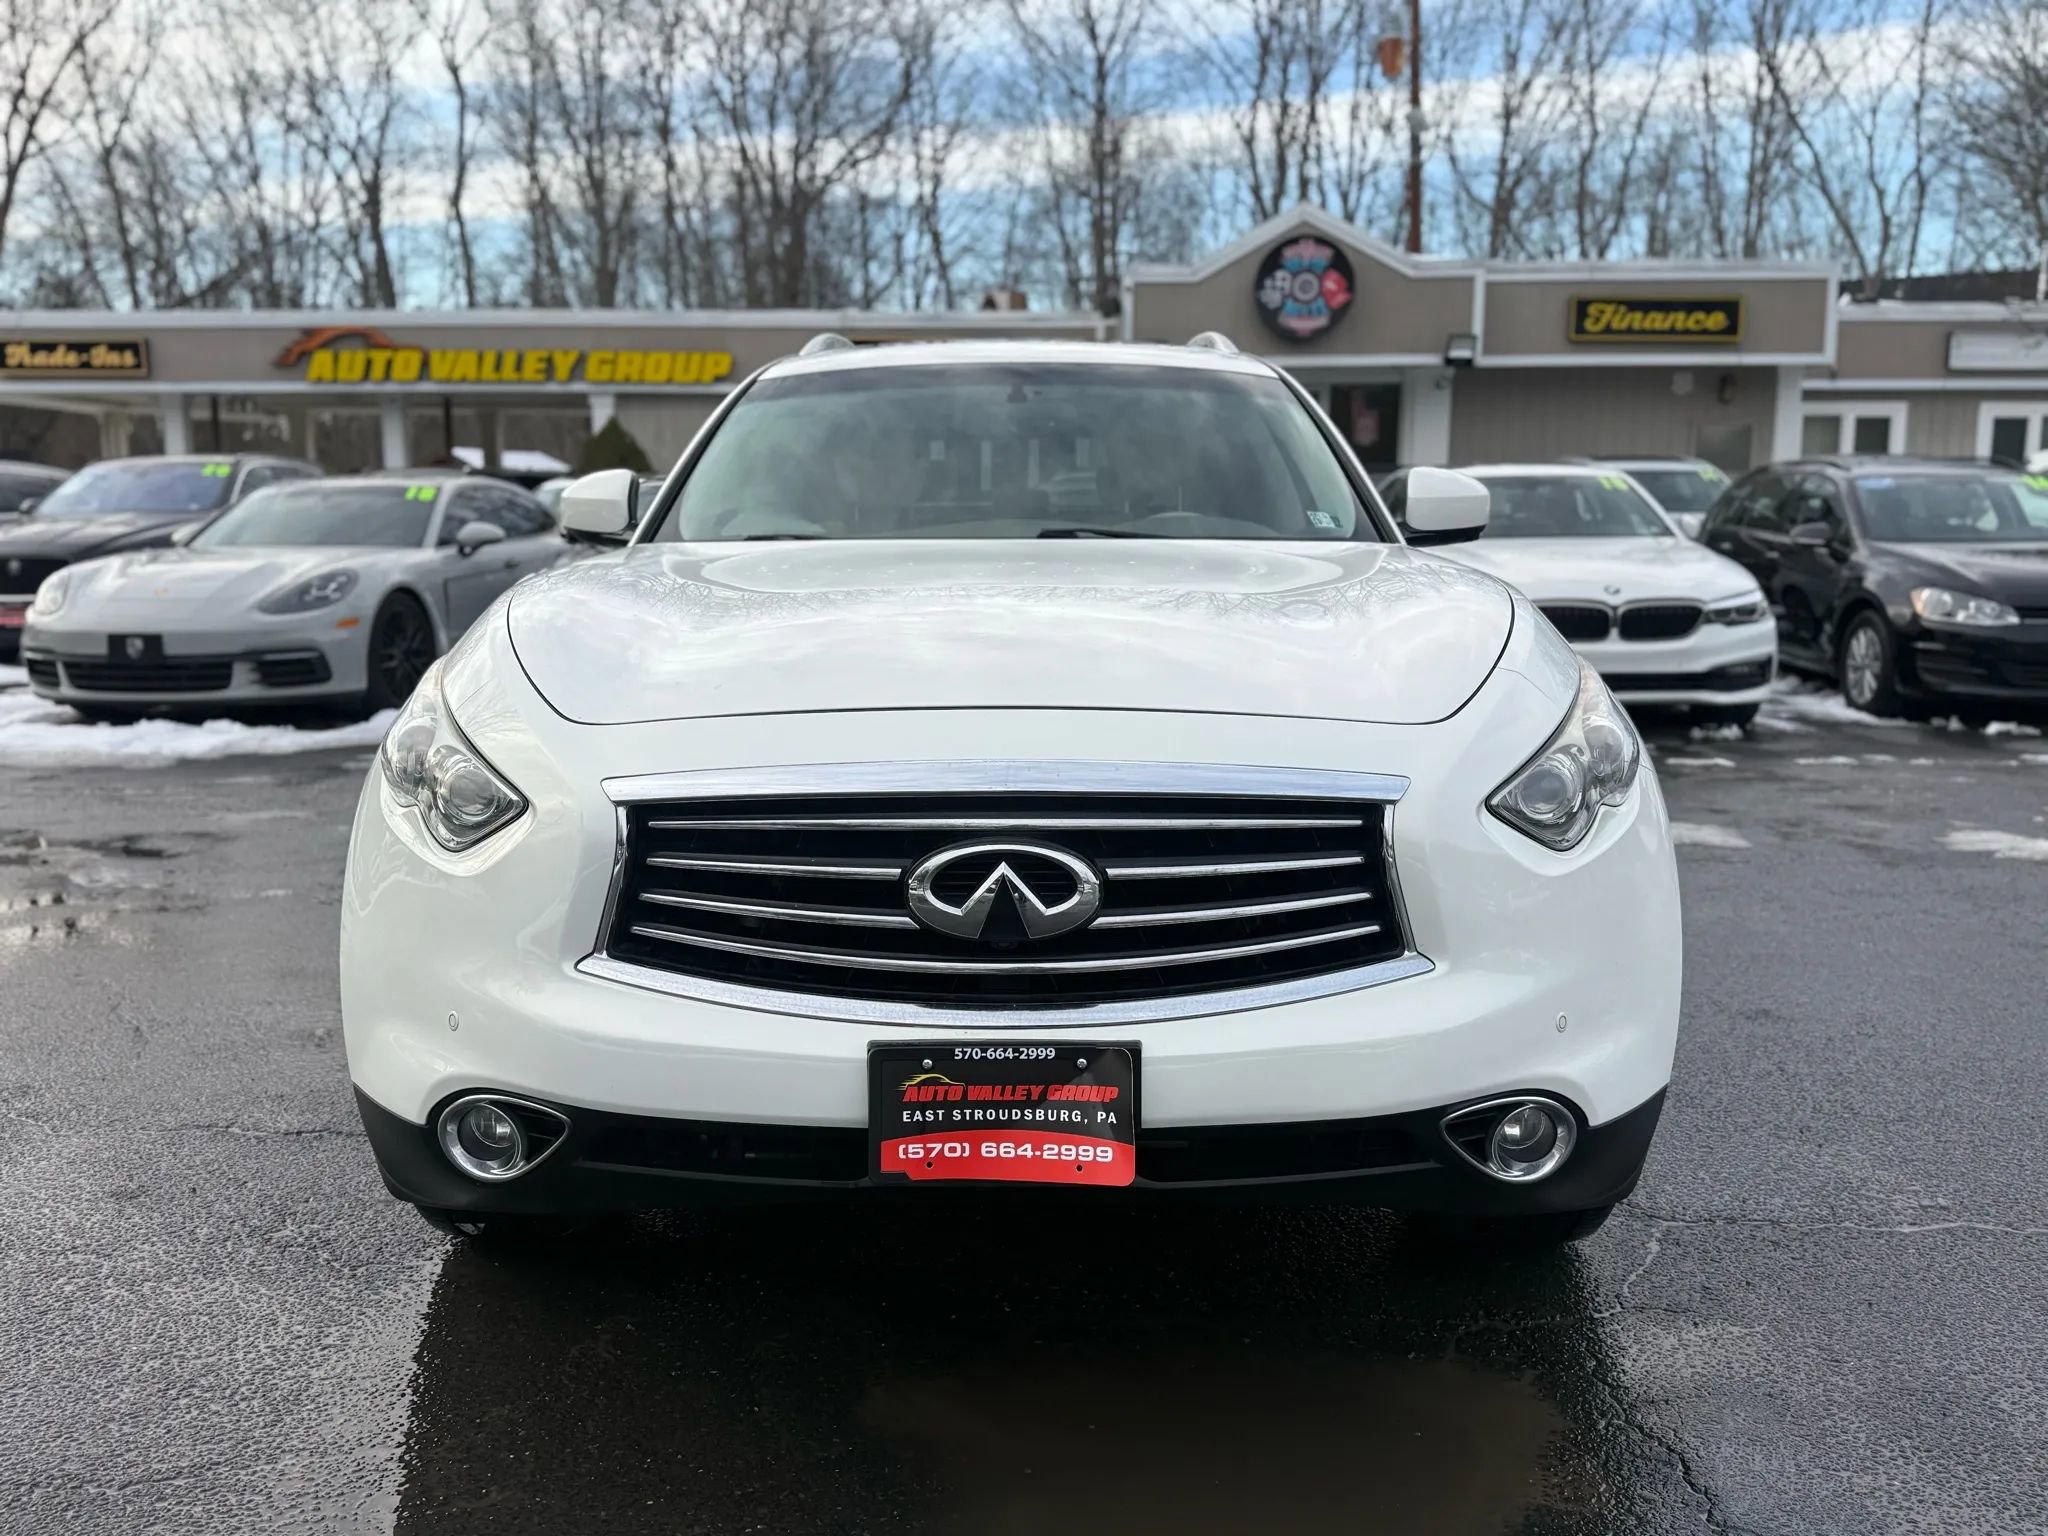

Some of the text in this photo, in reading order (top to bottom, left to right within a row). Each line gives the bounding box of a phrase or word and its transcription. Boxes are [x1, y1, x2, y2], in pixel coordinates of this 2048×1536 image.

[1583, 302, 1729, 333] Finance
[306, 349, 734, 384] AUTO VALLEY GROUP
[953, 1047, 1056, 1060] 570-664-2999
[902, 1084, 1120, 1103] AUTO VALLEY GROUP
[902, 1109, 1118, 1124] EAST STROUDSBURG, PA
[898, 1142, 1114, 1162] (570) 664-2999
